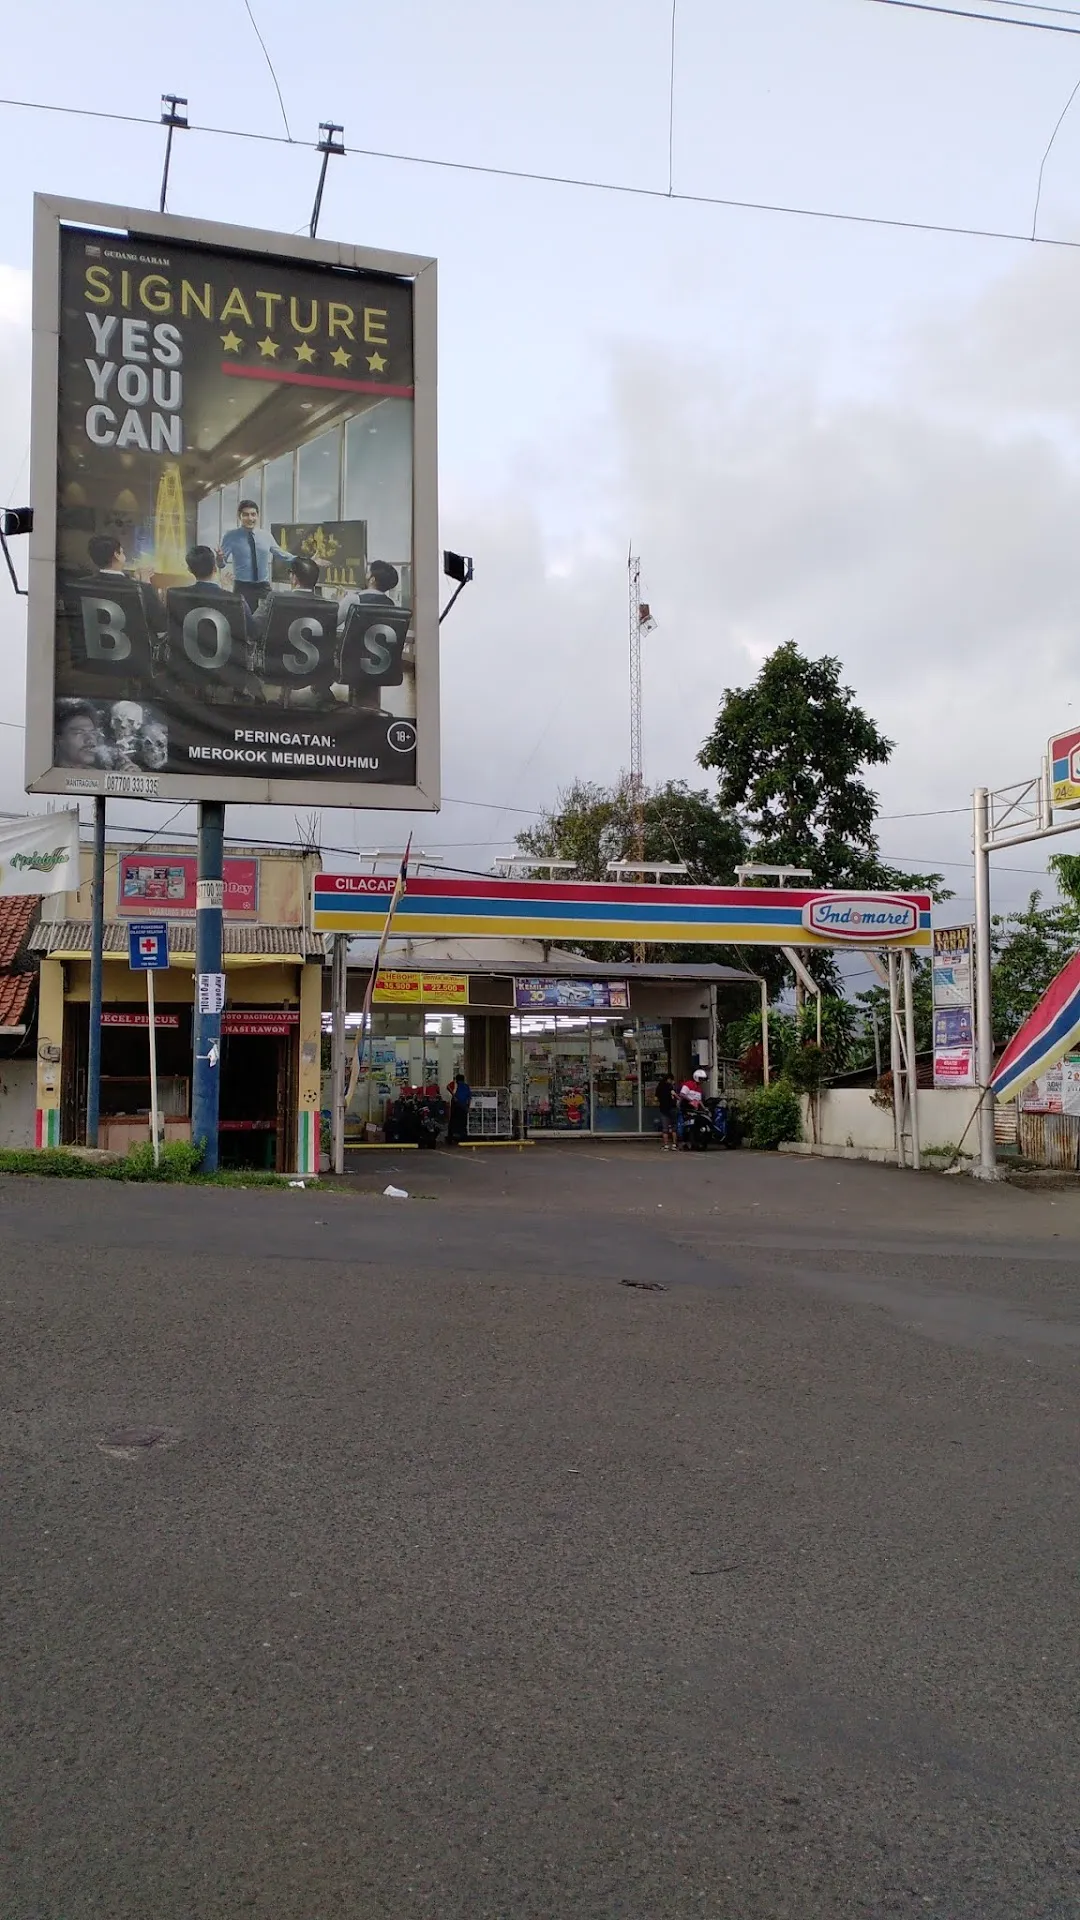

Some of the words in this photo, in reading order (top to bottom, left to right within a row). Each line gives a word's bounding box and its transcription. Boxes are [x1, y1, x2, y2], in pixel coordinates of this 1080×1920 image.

[104, 249, 137, 261] GUDANG
[139, 255, 170, 266] GARAM
[84, 265, 390, 345] SIGNATURE
[85, 312, 183, 367] YES
[86, 358, 183, 410] YOU
[85, 404, 183, 455] CAN
[234, 729, 336, 748] PERINGATAN:
[395, 731, 412, 743] 18+
[188, 746, 267, 763] MEROKOK
[271, 752, 379, 770] MEMBUNUHMU
[132, 776, 144, 793] 333
[229, 882, 253, 895] Day
[335, 878, 396, 892] CILACAP
[815, 905, 910, 925] Indomaret
